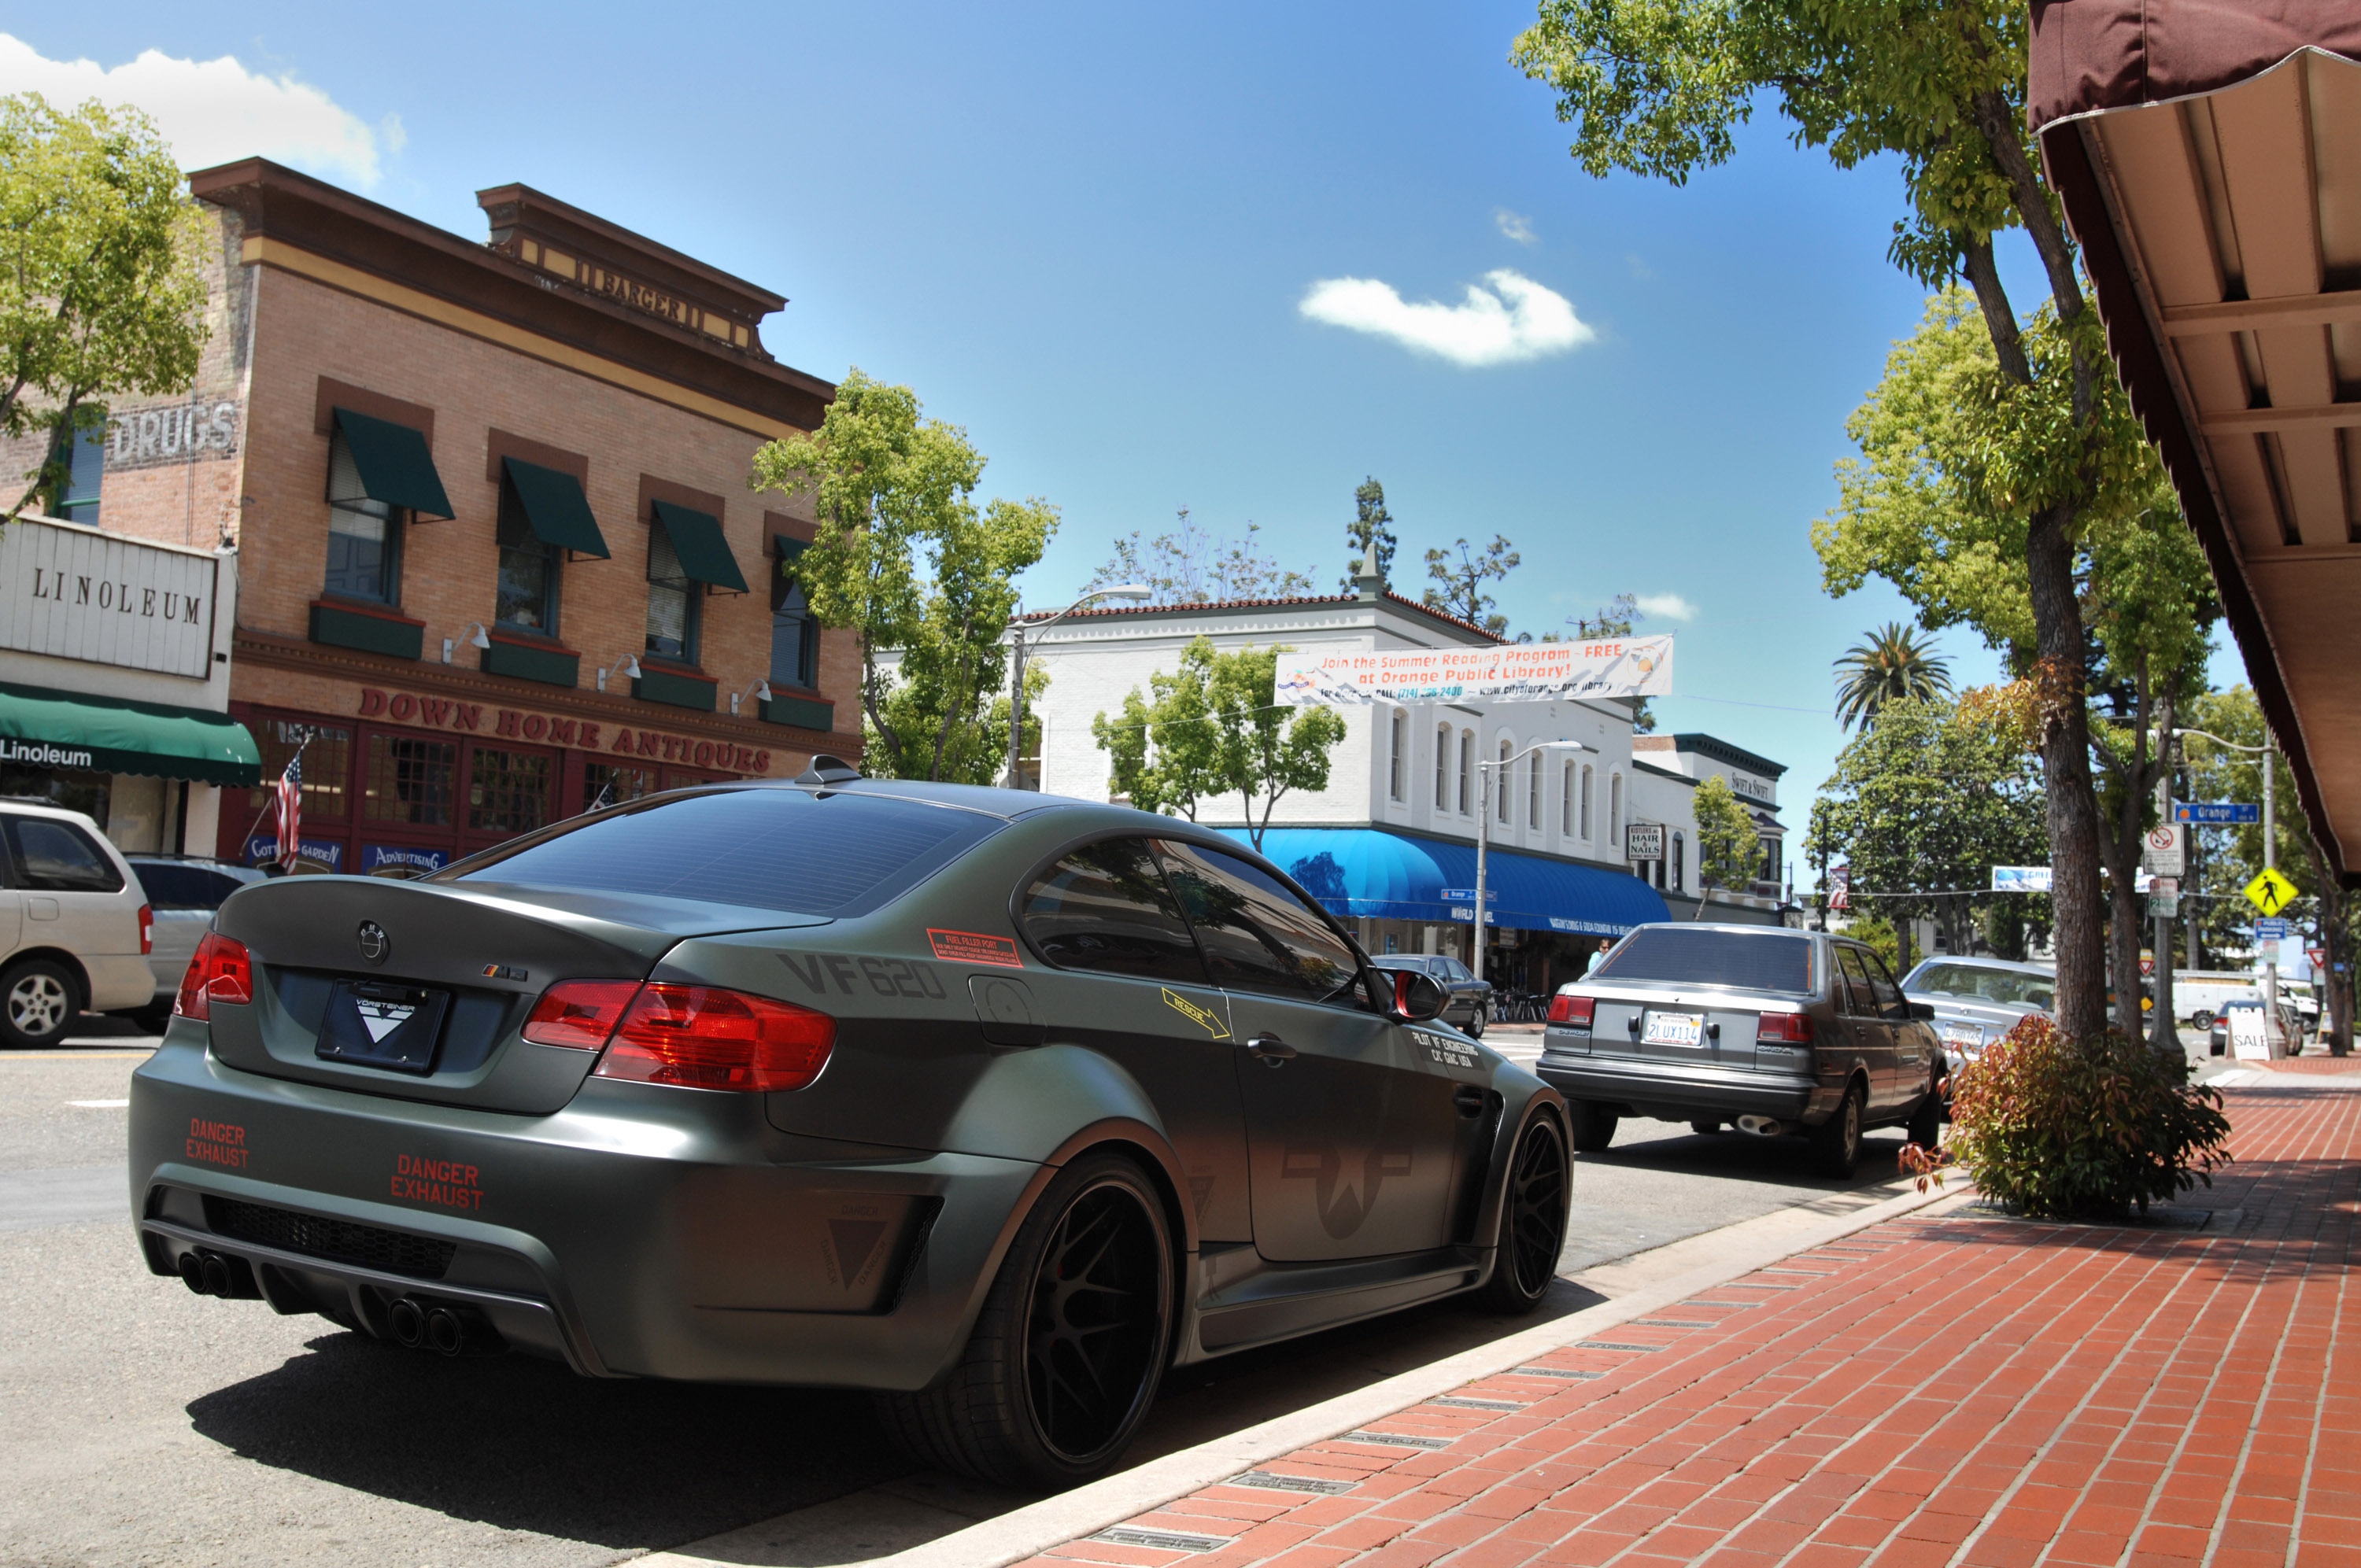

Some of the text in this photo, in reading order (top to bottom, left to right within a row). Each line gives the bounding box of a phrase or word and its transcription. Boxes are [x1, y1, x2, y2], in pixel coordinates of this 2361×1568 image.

[602, 272, 682, 319] BARGER
[113, 402, 235, 462] DRUGS
[33, 567, 201, 625] LINOLEUM
[1321, 656, 1349, 669] Join
[1354, 655, 1376, 668] the
[1381, 655, 1437, 669] Summer
[1443, 652, 1500, 666] Reading
[1506, 648, 1570, 664] Program
[1585, 644, 1623, 658] FREE
[1359, 663, 1571, 685] at Orange Public Library!
[1321, 688, 1334, 698] For
[1376, 688, 1395, 699] CALL:
[1398, 687, 1418, 699] (714)
[358, 688, 770, 773] DOWN HOME ANTIQUES
[0, 738, 92, 767] Linoleum
[1731, 771, 1769, 800] SWIFT & SWIFT
[2198, 806, 2231, 820] Orange
[301, 843, 339, 865] GARDEN
[374, 847, 440, 871] ADVERTISING
[1631, 845, 1660, 854] NAILS
[1451, 891, 1465, 899] Orange
[1451, 906, 1474, 921] WORLD
[360, 924, 385, 939] BMW
[945, 935, 998, 950] FUEL FILLER PORT
[1174, 998, 1205, 1023] RESCUE
[1411, 1031, 1479, 1057] PILOT VF ENGINEERING
[1649, 1024, 1698, 1040] 2LUX114
[2234, 1035, 2268, 1046] SALE
[1458, 1054, 1473, 1068] USA
[190, 1117, 246, 1146] DANGER
[186, 1138, 249, 1169] EXHAUST
[397, 1153, 479, 1187] DANGER
[390, 1175, 486, 1211] EXHAUST
[841, 1205, 879, 1216] DANGER
[820, 1238, 838, 1285] DANGER
